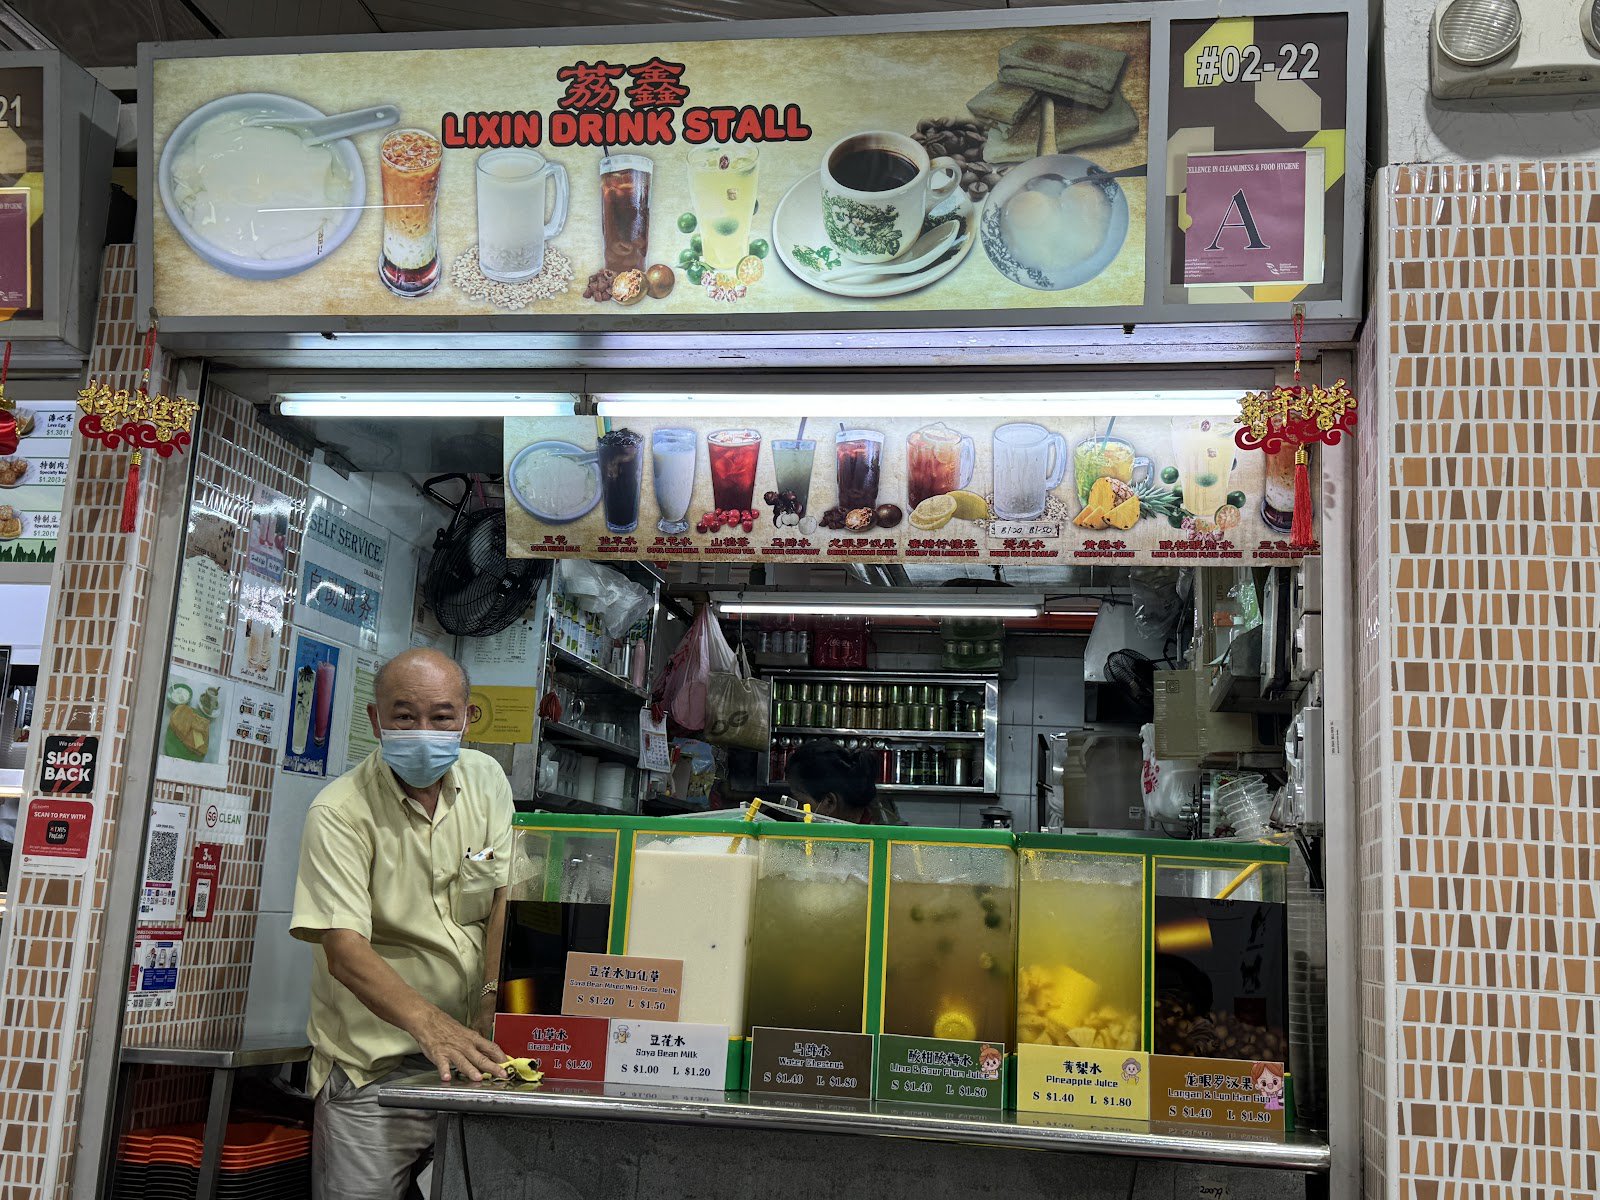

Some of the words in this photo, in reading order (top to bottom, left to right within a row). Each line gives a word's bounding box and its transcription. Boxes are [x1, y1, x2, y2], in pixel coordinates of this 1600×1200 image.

[1197, 42, 1320, 85] #02-22
[557, 57, 690, 110] 荔鑫
[442, 110, 542, 148] LIXIN
[549, 108, 675, 146] DRINK
[682, 104, 811, 144] STALL
[1220, 164, 1254, 172] CLEANLINESS
[1277, 162, 1300, 170] HYGIENE
[1204, 188, 1271, 251] A
[310, 513, 338, 540] SELF
[311, 568, 372, 620] 自助服务
[46, 751, 92, 766] SHOP
[44, 767, 91, 782] BACK
[208, 811, 217, 821] SG
[219, 813, 241, 824] CLEAN
[196, 862, 217, 870] Cashback
[589, 965, 660, 982] 豆花水加仙草
[660, 987, 677, 995] Jelly
[577, 995, 584, 1003] S
[589, 997, 615, 1006] $1.20
[628, 999, 634, 1008] L
[640, 1000, 666, 1010] $1.50
[532, 1027, 568, 1041] 仙草水
[650, 1034, 686, 1047] 豆花水
[551, 1043, 571, 1053] Jelly
[636, 1049, 655, 1057] Soya
[680, 1050, 698, 1058] Milk
[793, 1042, 831, 1057] 马蹄水
[554, 1059, 561, 1068] L
[566, 1060, 592, 1070] $1.20
[778, 1056, 805, 1066] Water
[805, 1058, 844, 1069] Chestnut
[908, 1048, 973, 1068] 酸柑酸梅水
[621, 1064, 628, 1072] S
[633, 1064, 659, 1074] $1.00
[673, 1067, 679, 1075] L
[685, 1067, 710, 1076] $1.20
[890, 1063, 911, 1072] Lime
[912, 1065, 920, 1074] &
[921, 1066, 942, 1076] Sour
[943, 1068, 965, 1078] Plum
[966, 1070, 989, 1080] Juice
[1063, 1060, 1102, 1075] 黄梨水
[764, 1072, 771, 1082] S
[776, 1072, 804, 1084] $1.40
[816, 1076, 825, 1086] L
[829, 1076, 857, 1088] $1.80
[1046, 1075, 1092, 1086] Pineapple
[1095, 1079, 1118, 1088] Juice
[1185, 1072, 1253, 1091] 龙眼罗汉果
[891, 1079, 899, 1090] S
[904, 1080, 932, 1092] $1.40
[946, 1084, 954, 1094] L
[959, 1084, 987, 1097] $1.80
[1168, 1088, 1202, 1099] Longan
[1204, 1091, 1211, 1099] &
[1213, 1091, 1230, 1100] Luo
[1232, 1093, 1252, 1102] Han
[1253, 1094, 1271, 1103] Guo
[1033, 1091, 1040, 1100] S
[1046, 1092, 1074, 1102] $1.40
[1090, 1096, 1096, 1104] L
[1104, 1096, 1132, 1107] $1.80
[1169, 1106, 1176, 1116] S
[1183, 1106, 1212, 1118] $1.40
[1227, 1109, 1235, 1120] L
[1241, 1110, 1271, 1122] $1.80
